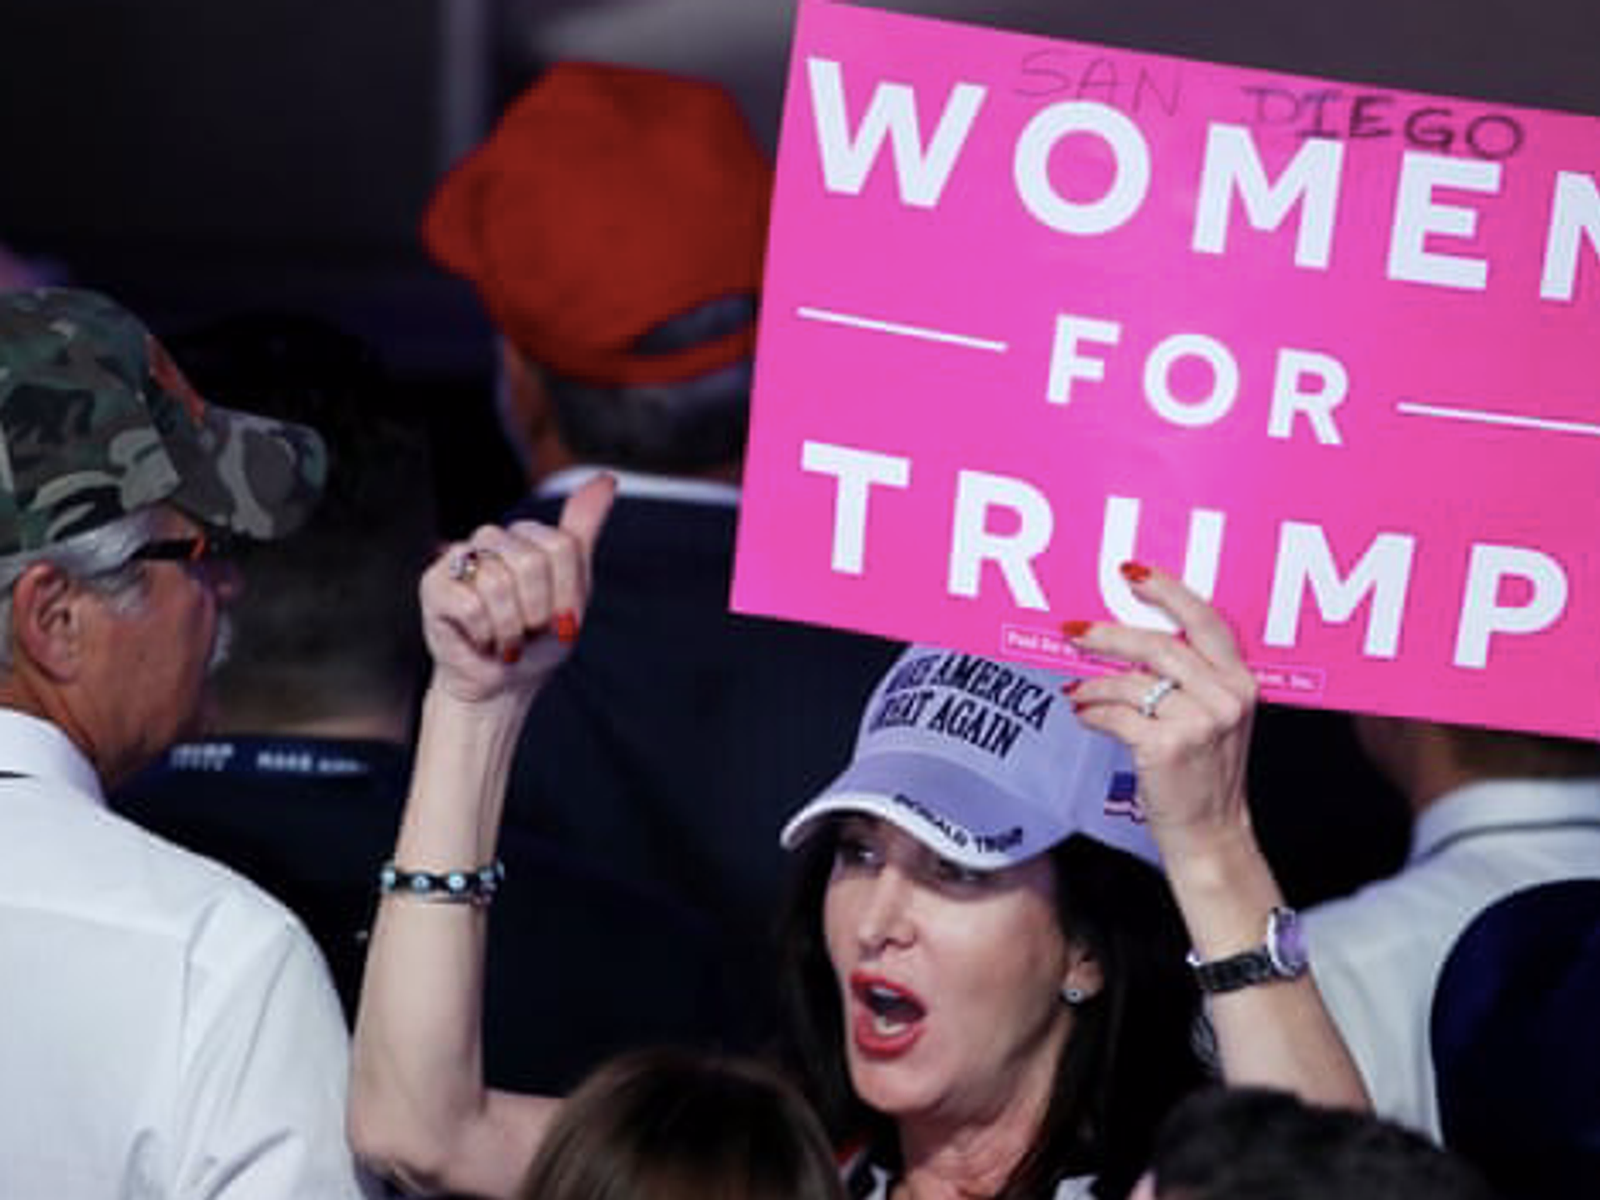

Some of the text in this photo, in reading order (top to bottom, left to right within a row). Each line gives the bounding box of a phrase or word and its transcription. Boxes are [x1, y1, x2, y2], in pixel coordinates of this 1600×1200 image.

[1013, 47, 1526, 160] SAN DIEGO
[1046, 313, 1350, 446] FOR
[800, 440, 1568, 670] TRUMP
[926, 692, 1023, 758] AGAIN
[929, 651, 1055, 733] AMERICA
